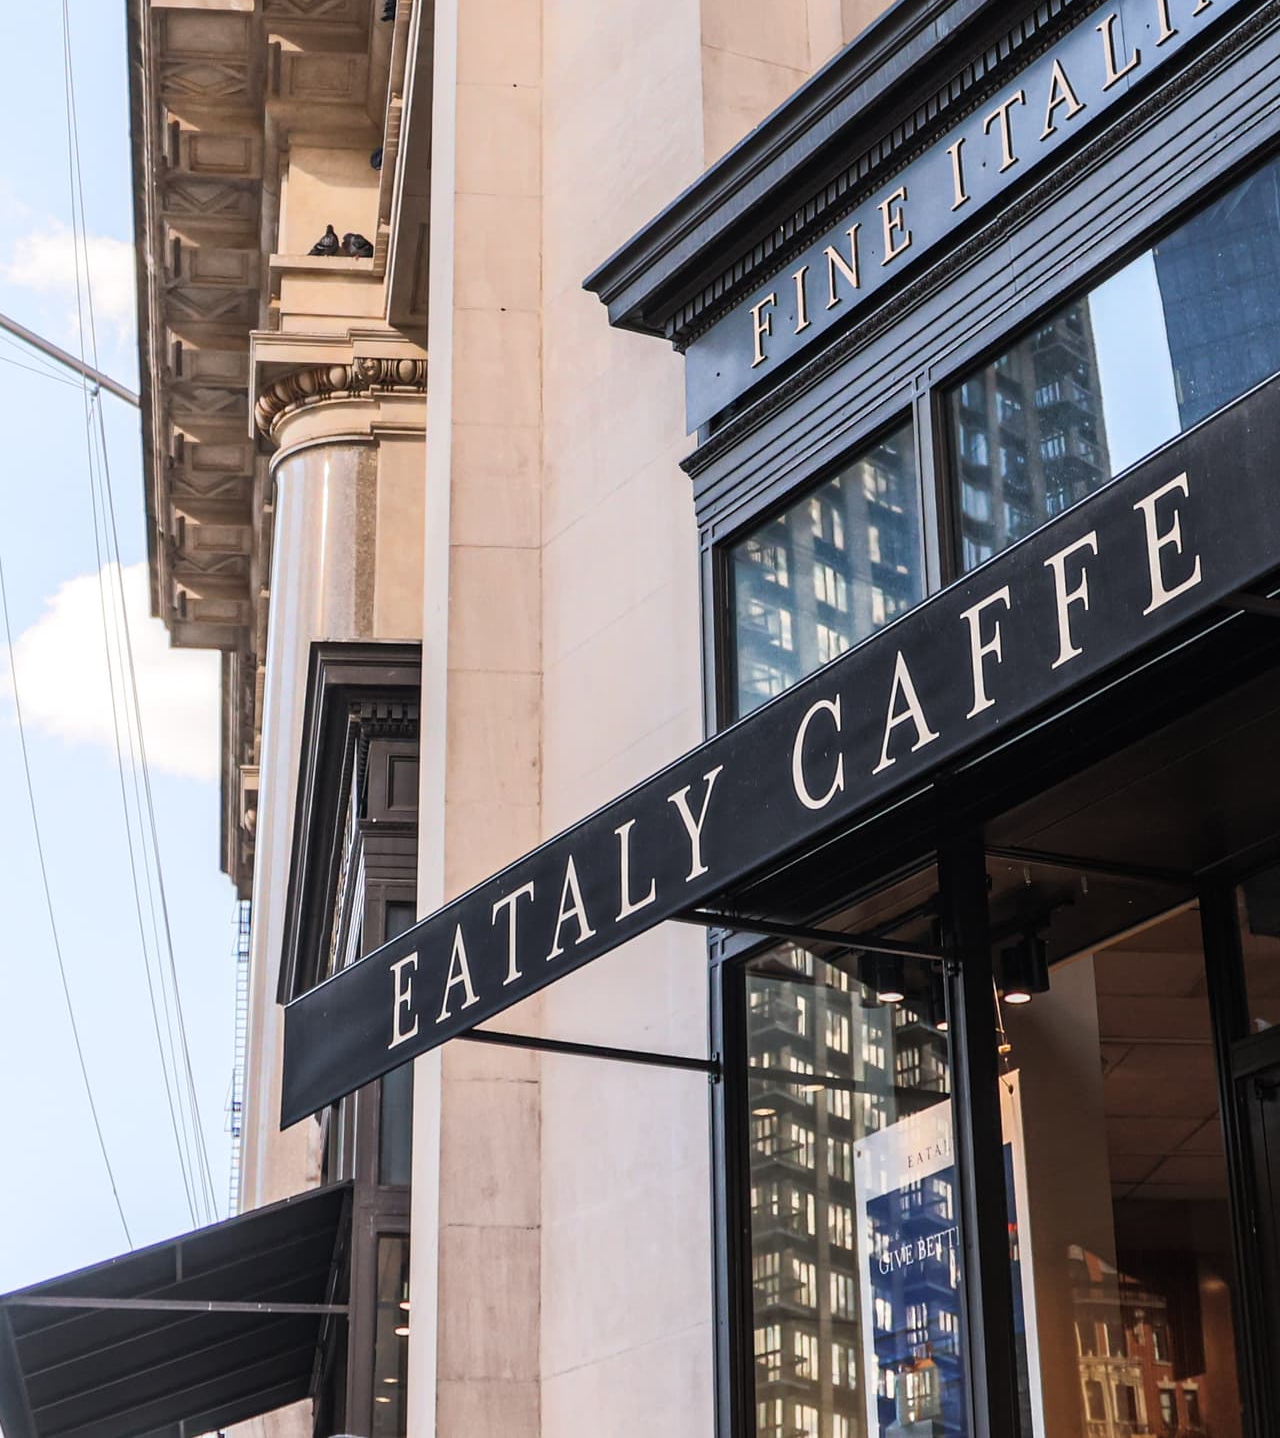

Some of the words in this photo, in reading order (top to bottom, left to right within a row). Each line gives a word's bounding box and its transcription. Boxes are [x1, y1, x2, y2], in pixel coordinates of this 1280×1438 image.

[749, 186, 912, 370] FINE
[387, 764, 724, 1052] EATALY
[791, 470, 1204, 812] CAFFE
[907, 1139, 951, 1168] EATAL
[878, 1243, 914, 1275] GIVE
